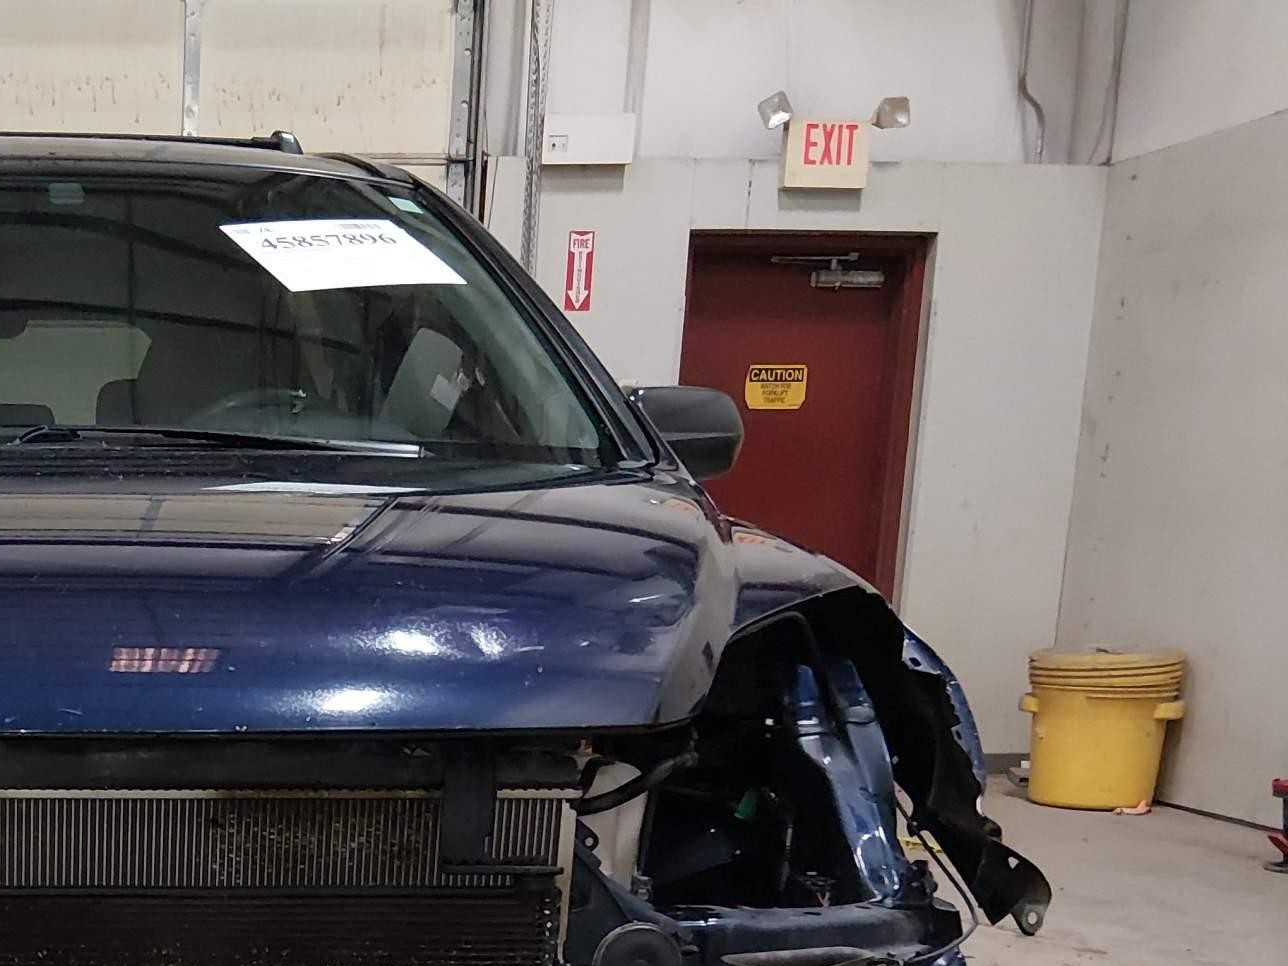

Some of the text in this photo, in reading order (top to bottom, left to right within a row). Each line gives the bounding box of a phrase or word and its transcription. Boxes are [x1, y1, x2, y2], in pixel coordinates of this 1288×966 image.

[803, 123, 859, 166] EXIT
[261, 232, 397, 249] 45857896
[572, 238, 591, 249] FIRE
[751, 369, 803, 381] CAUTION
